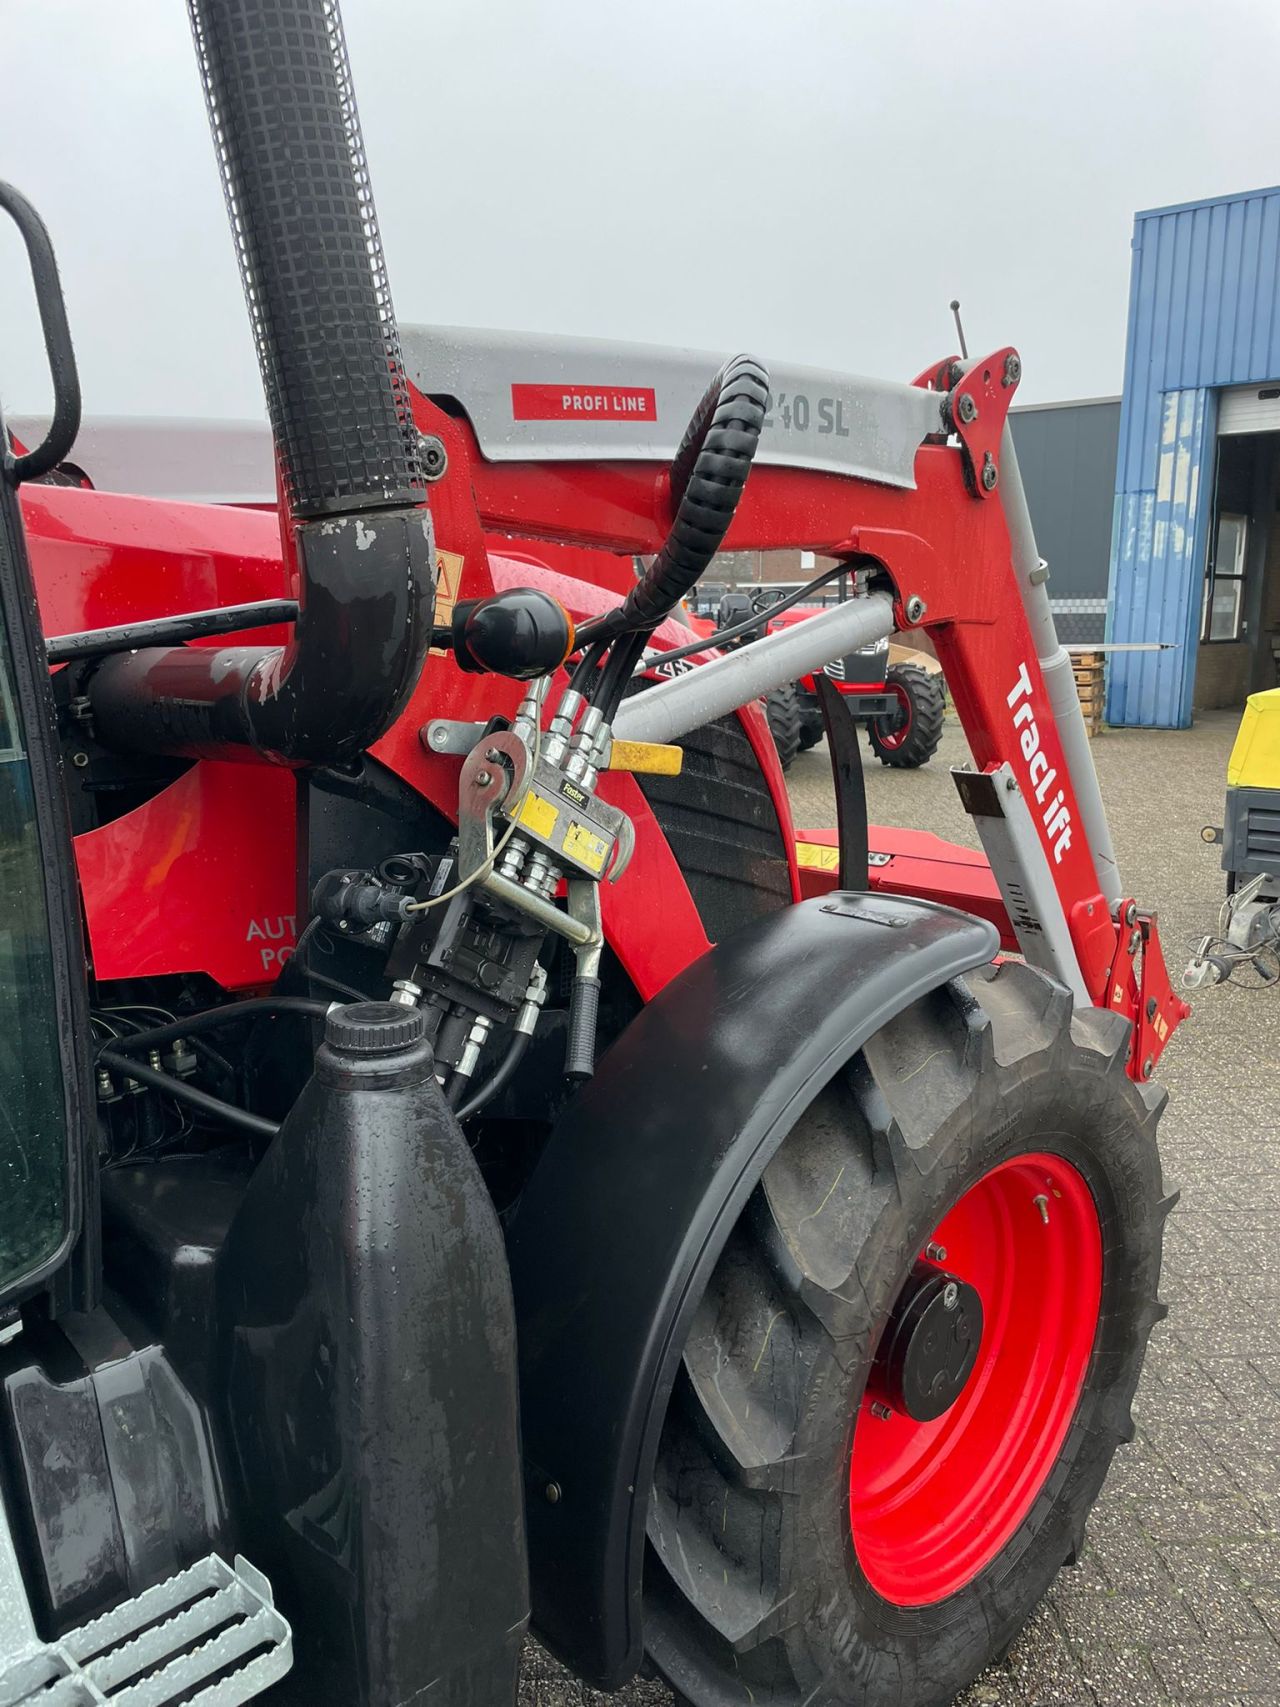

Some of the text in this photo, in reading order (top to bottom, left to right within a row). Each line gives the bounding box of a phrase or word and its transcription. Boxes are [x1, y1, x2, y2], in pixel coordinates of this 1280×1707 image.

[562, 395, 646, 412] PROFI LINE
[818, 397, 850, 437] SL
[1006, 662, 1073, 865] TracLift
